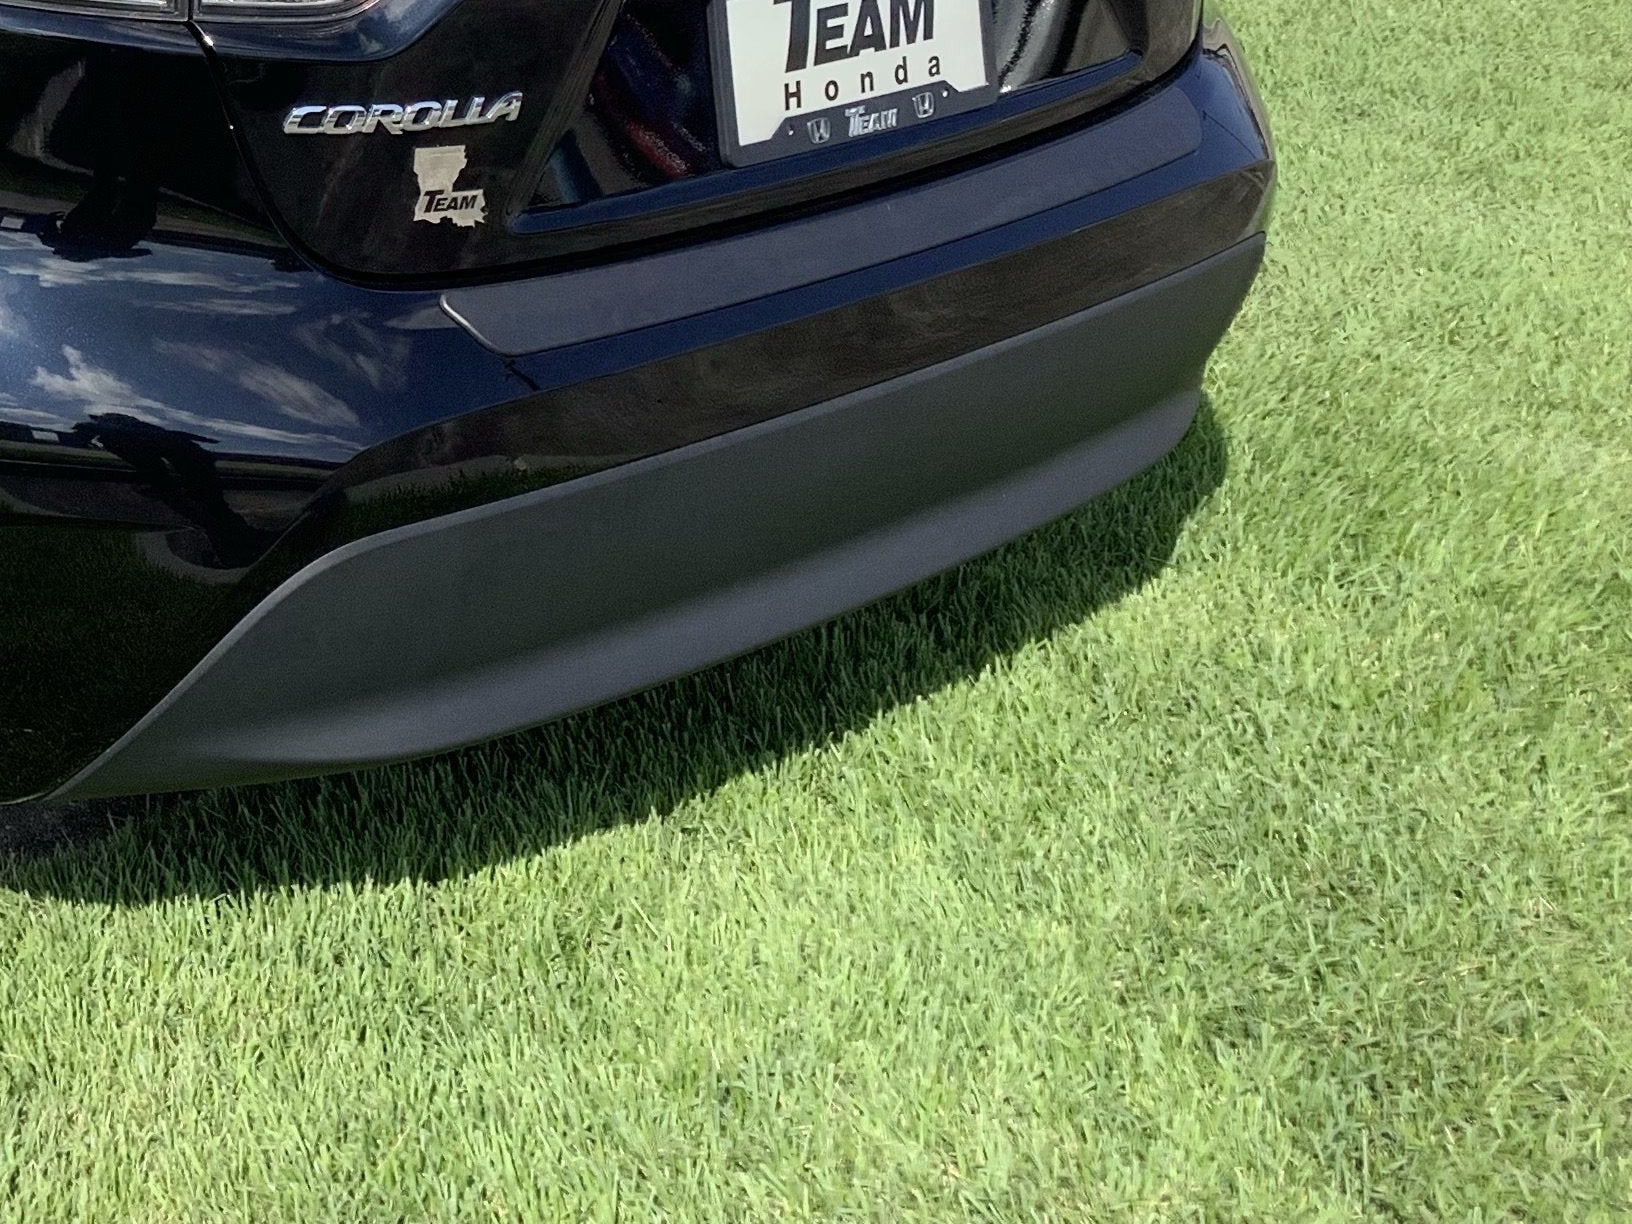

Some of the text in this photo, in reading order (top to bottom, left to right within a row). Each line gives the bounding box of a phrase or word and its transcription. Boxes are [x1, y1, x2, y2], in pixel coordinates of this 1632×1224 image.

[783, 54, 942, 111] Honda
[283, 91, 523, 135] COROLLA
[844, 105, 899, 138] TEAM
[423, 190, 478, 213] TEAM
